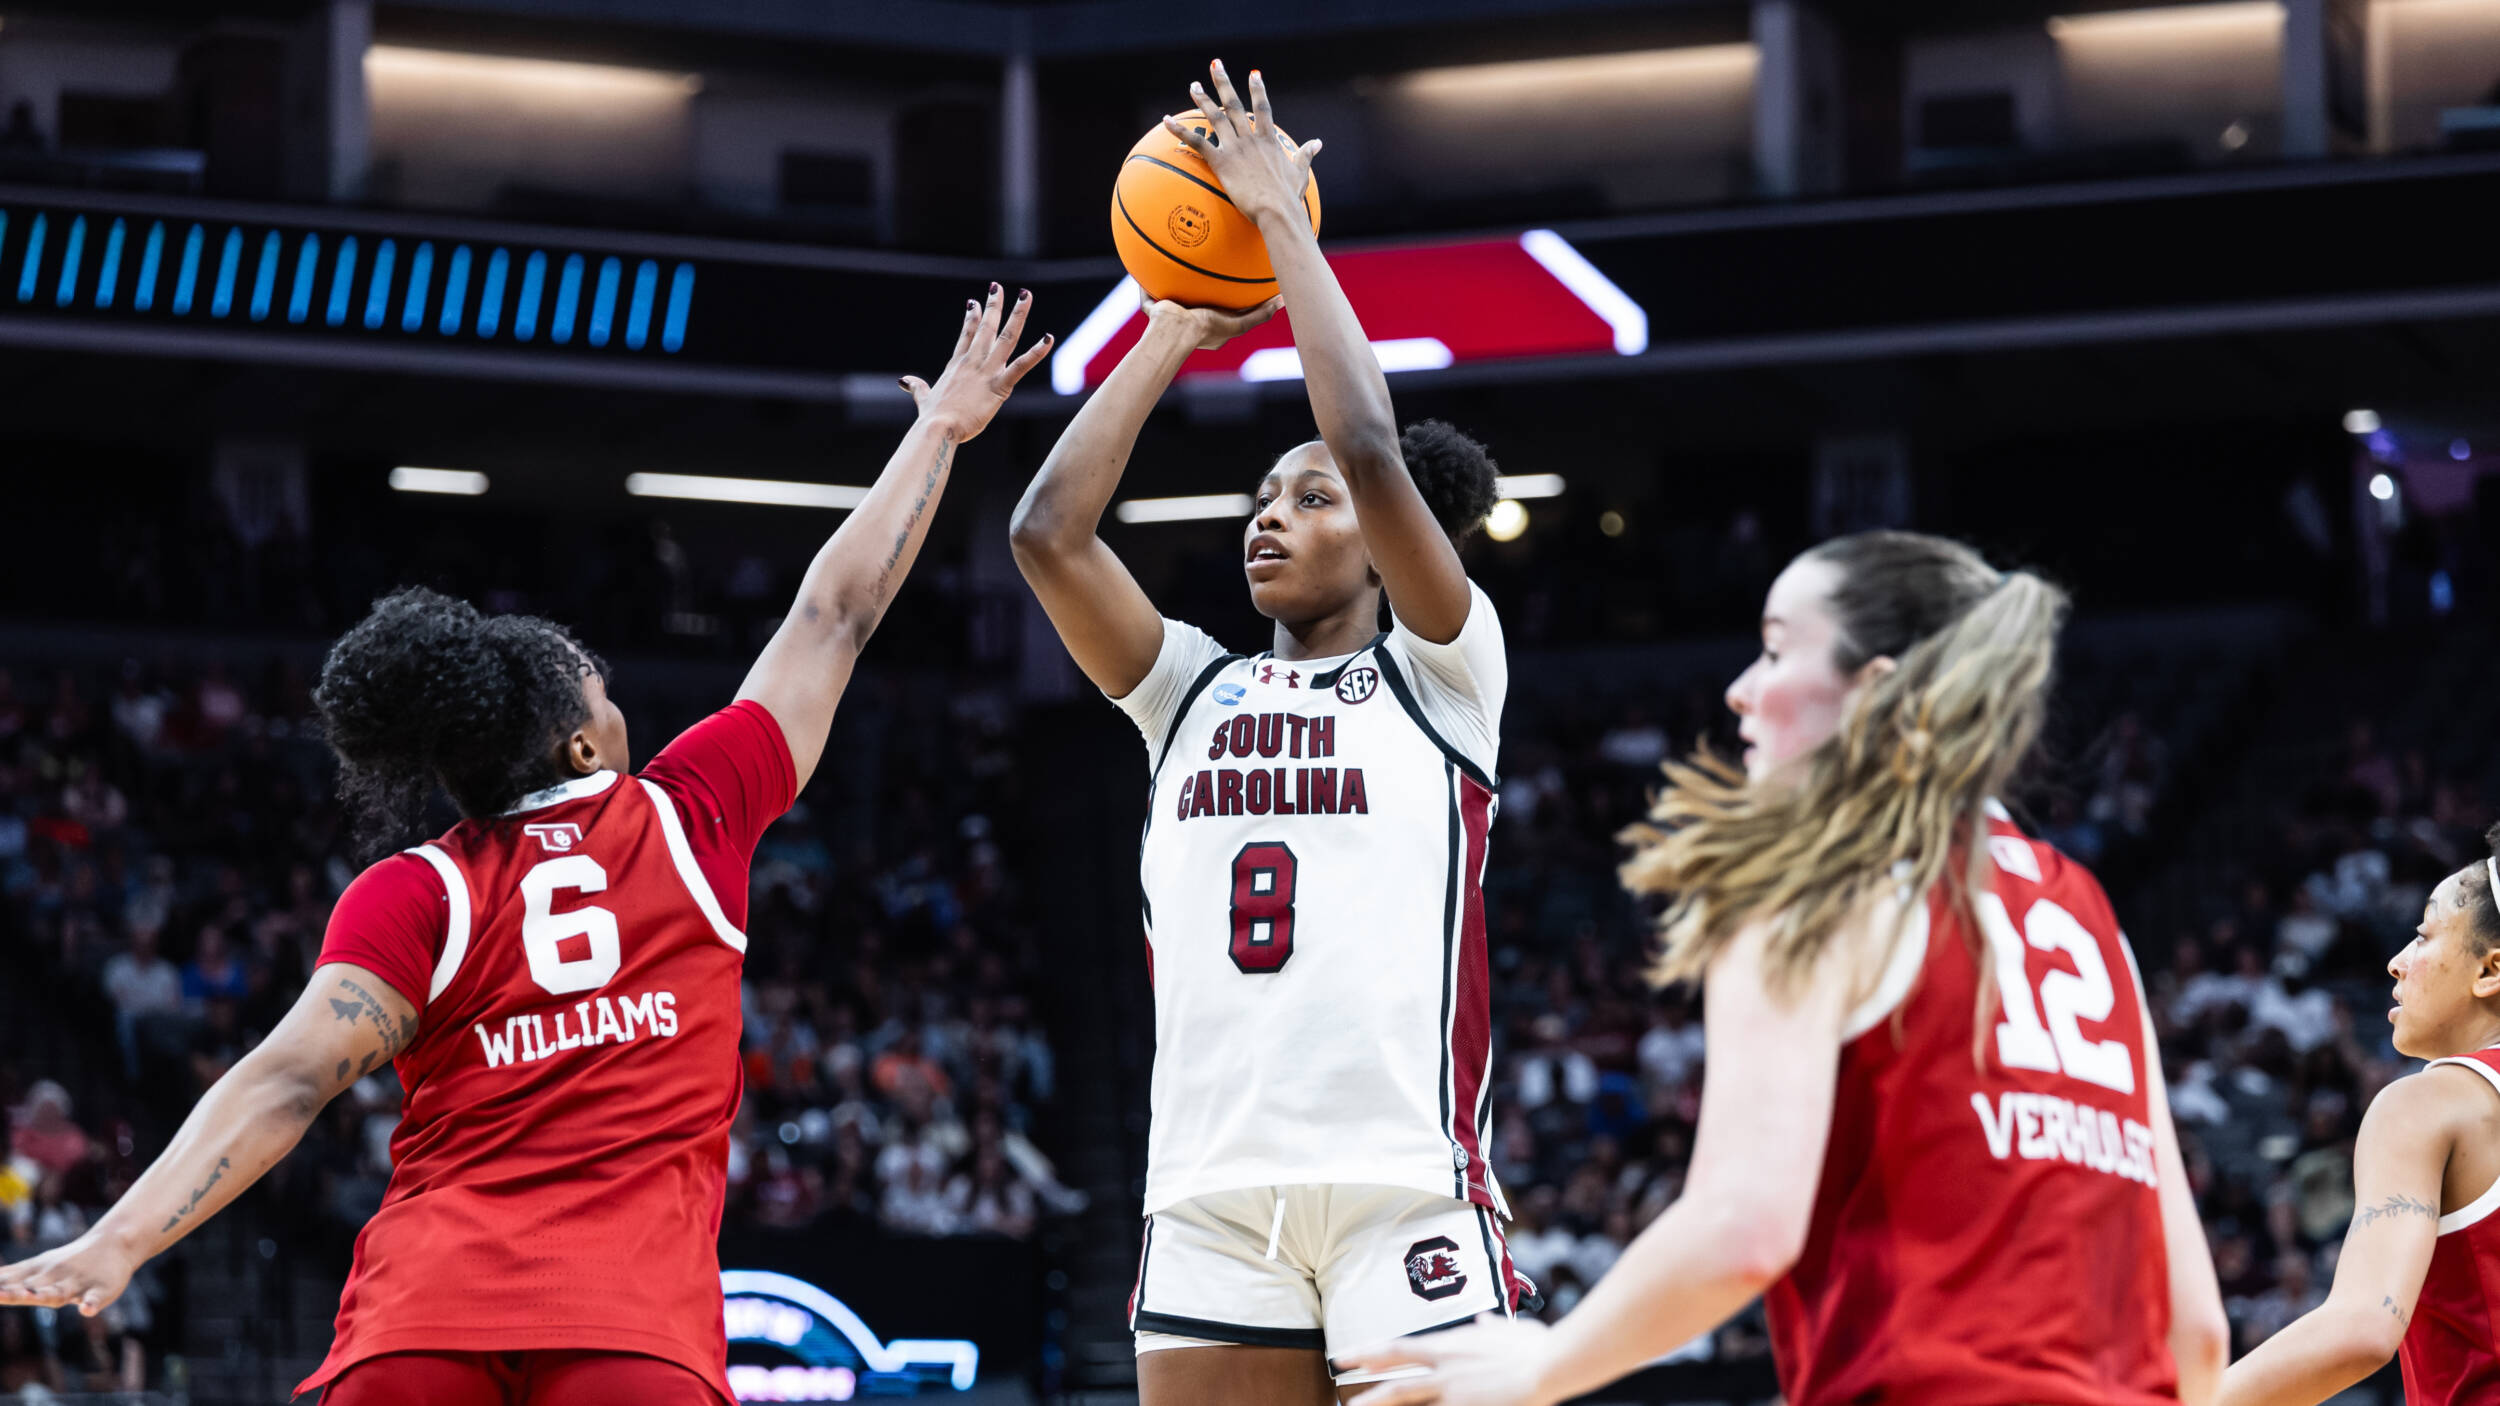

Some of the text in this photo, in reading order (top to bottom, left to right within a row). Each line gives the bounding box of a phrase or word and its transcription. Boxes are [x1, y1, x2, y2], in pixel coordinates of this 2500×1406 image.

[1339, 669, 1376, 702] SEC
[1208, 713, 1335, 760] SOUTH
[1177, 768, 1369, 821] CAROLINA
[520, 854, 621, 995] 6
[1228, 841, 1298, 974] 8
[474, 991, 678, 1068] WILLIAMS
[1976, 891, 2135, 1095] 12
